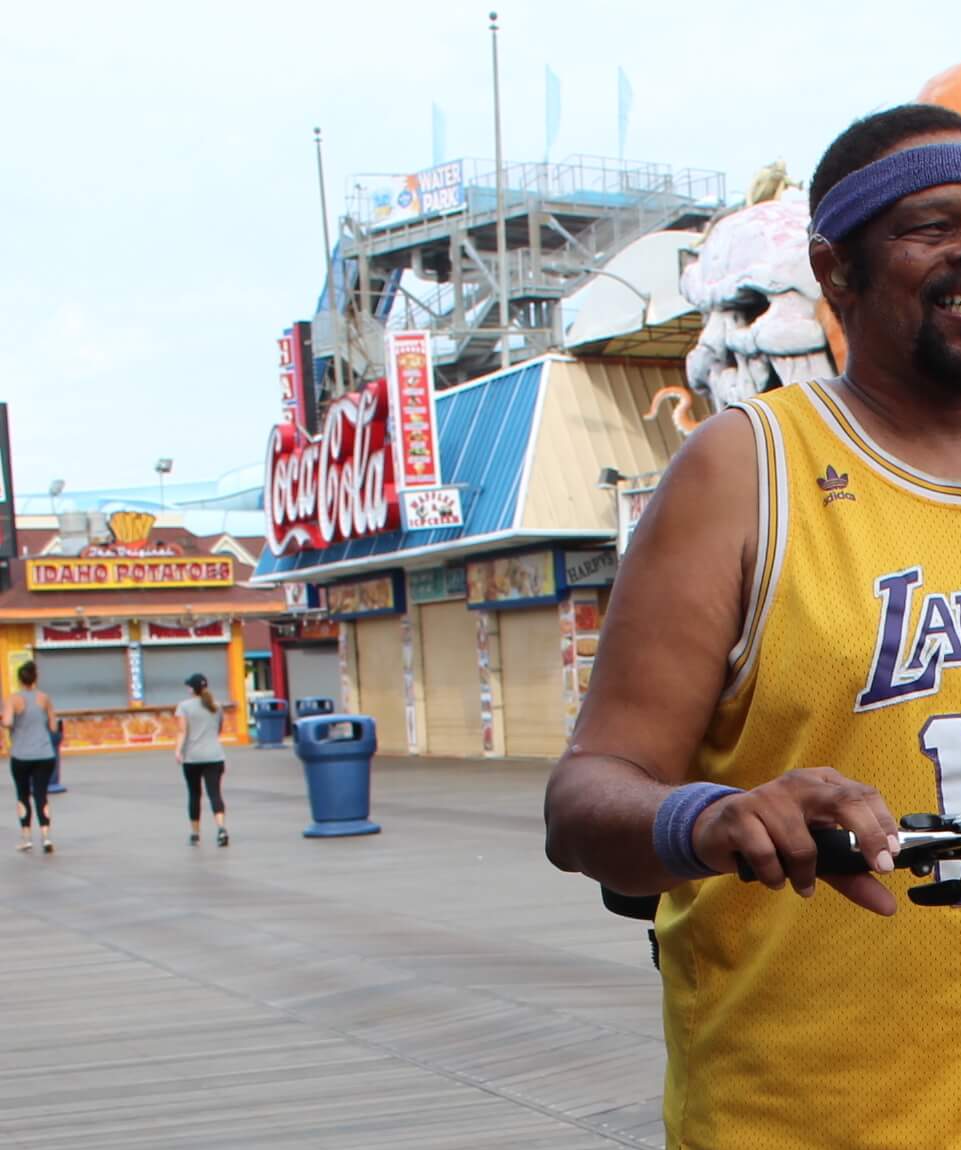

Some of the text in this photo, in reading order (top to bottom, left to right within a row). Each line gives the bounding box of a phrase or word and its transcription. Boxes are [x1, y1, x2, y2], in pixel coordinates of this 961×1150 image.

[419, 163, 462, 192] WATER
[422, 187, 460, 215] PARK
[823, 491, 857, 507] adidas
[35, 562, 230, 584] IDAHO POTATOES
